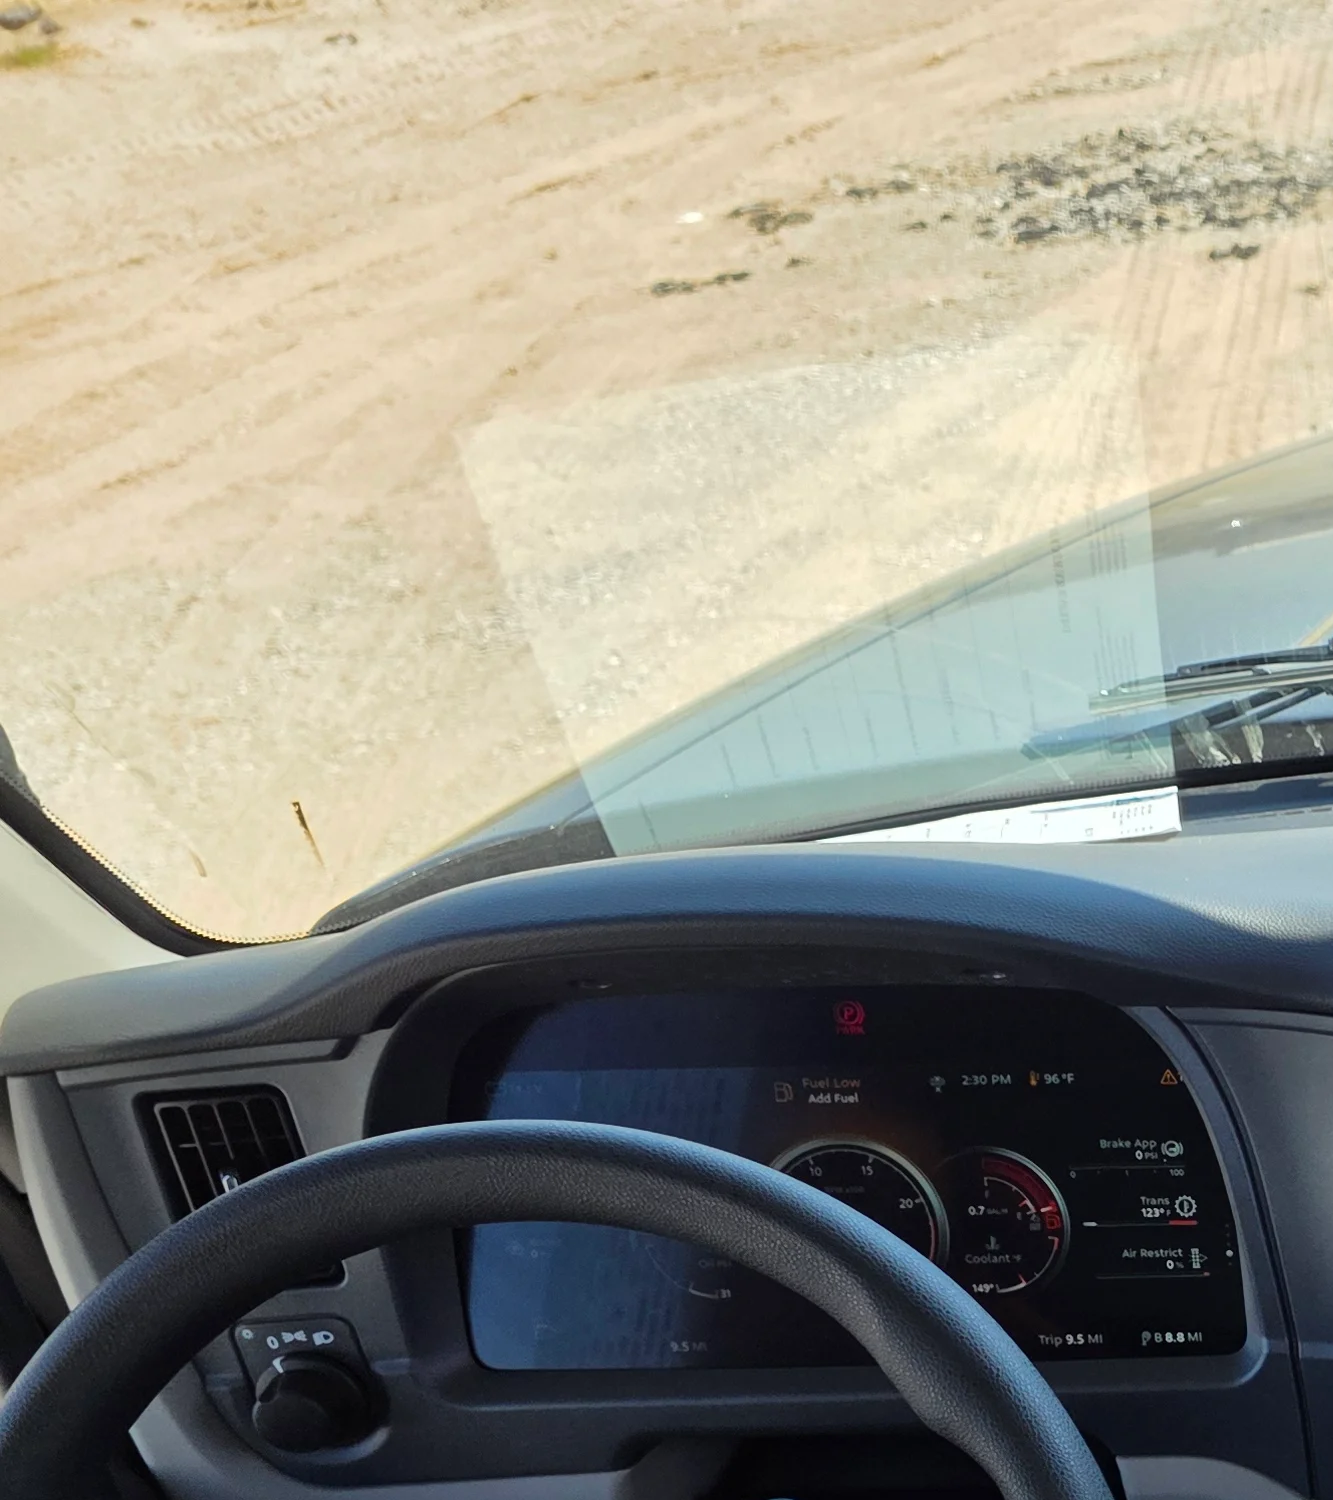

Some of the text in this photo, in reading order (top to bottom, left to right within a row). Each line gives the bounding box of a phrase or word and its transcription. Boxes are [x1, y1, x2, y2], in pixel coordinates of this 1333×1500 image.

[802, 1077, 861, 1089] Fuel Low
[962, 1074, 1012, 1086] 2:30 PM
[1043, 1074, 1059, 1085] 96
[808, 1092, 860, 1104] Add Fuel
[1100, 1138, 1158, 1151] Brake App
[1135, 1150, 1144, 1160] 0
[809, 1167, 822, 1177] 10
[861, 1165, 874, 1176] 15
[1168, 1168, 1186, 1177] 100
[899, 1198, 914, 1209] 20
[1140, 1196, 1171, 1206] Trans
[967, 1205, 986, 1216] 0.7
[964, 1253, 1011, 1264] Coolant
[1121, 1248, 1183, 1258] Air Restrict
[1166, 1260, 1174, 1270] 0
[1039, 1334, 1103, 1347] Trip 9.5 MI
[1165, 1332, 1185, 1343] 8.8
[1188, 1332, 1203, 1343] MI
